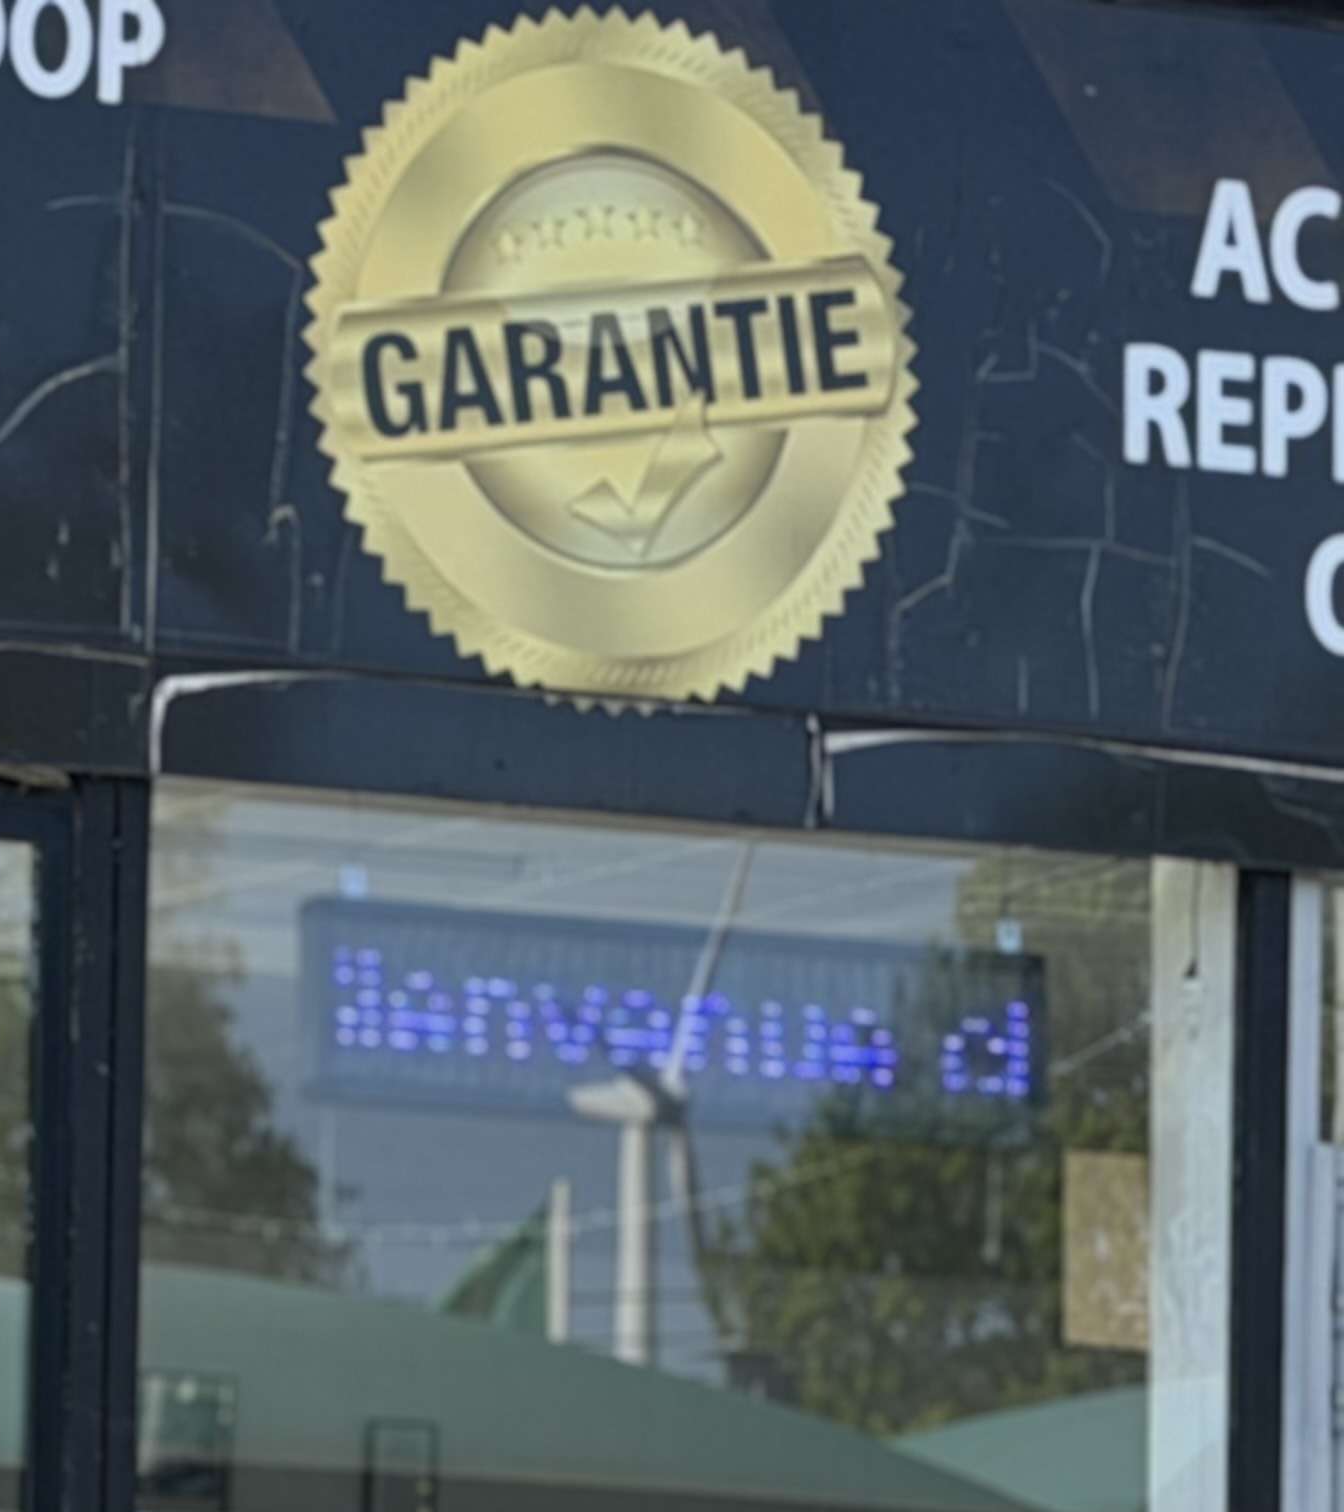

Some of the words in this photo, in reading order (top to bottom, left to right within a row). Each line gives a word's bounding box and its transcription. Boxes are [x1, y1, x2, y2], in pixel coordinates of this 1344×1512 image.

[1190, 177, 1342, 311] AC
[360, 287, 871, 440] GARANTIE
[1122, 342, 1344, 484] REP
